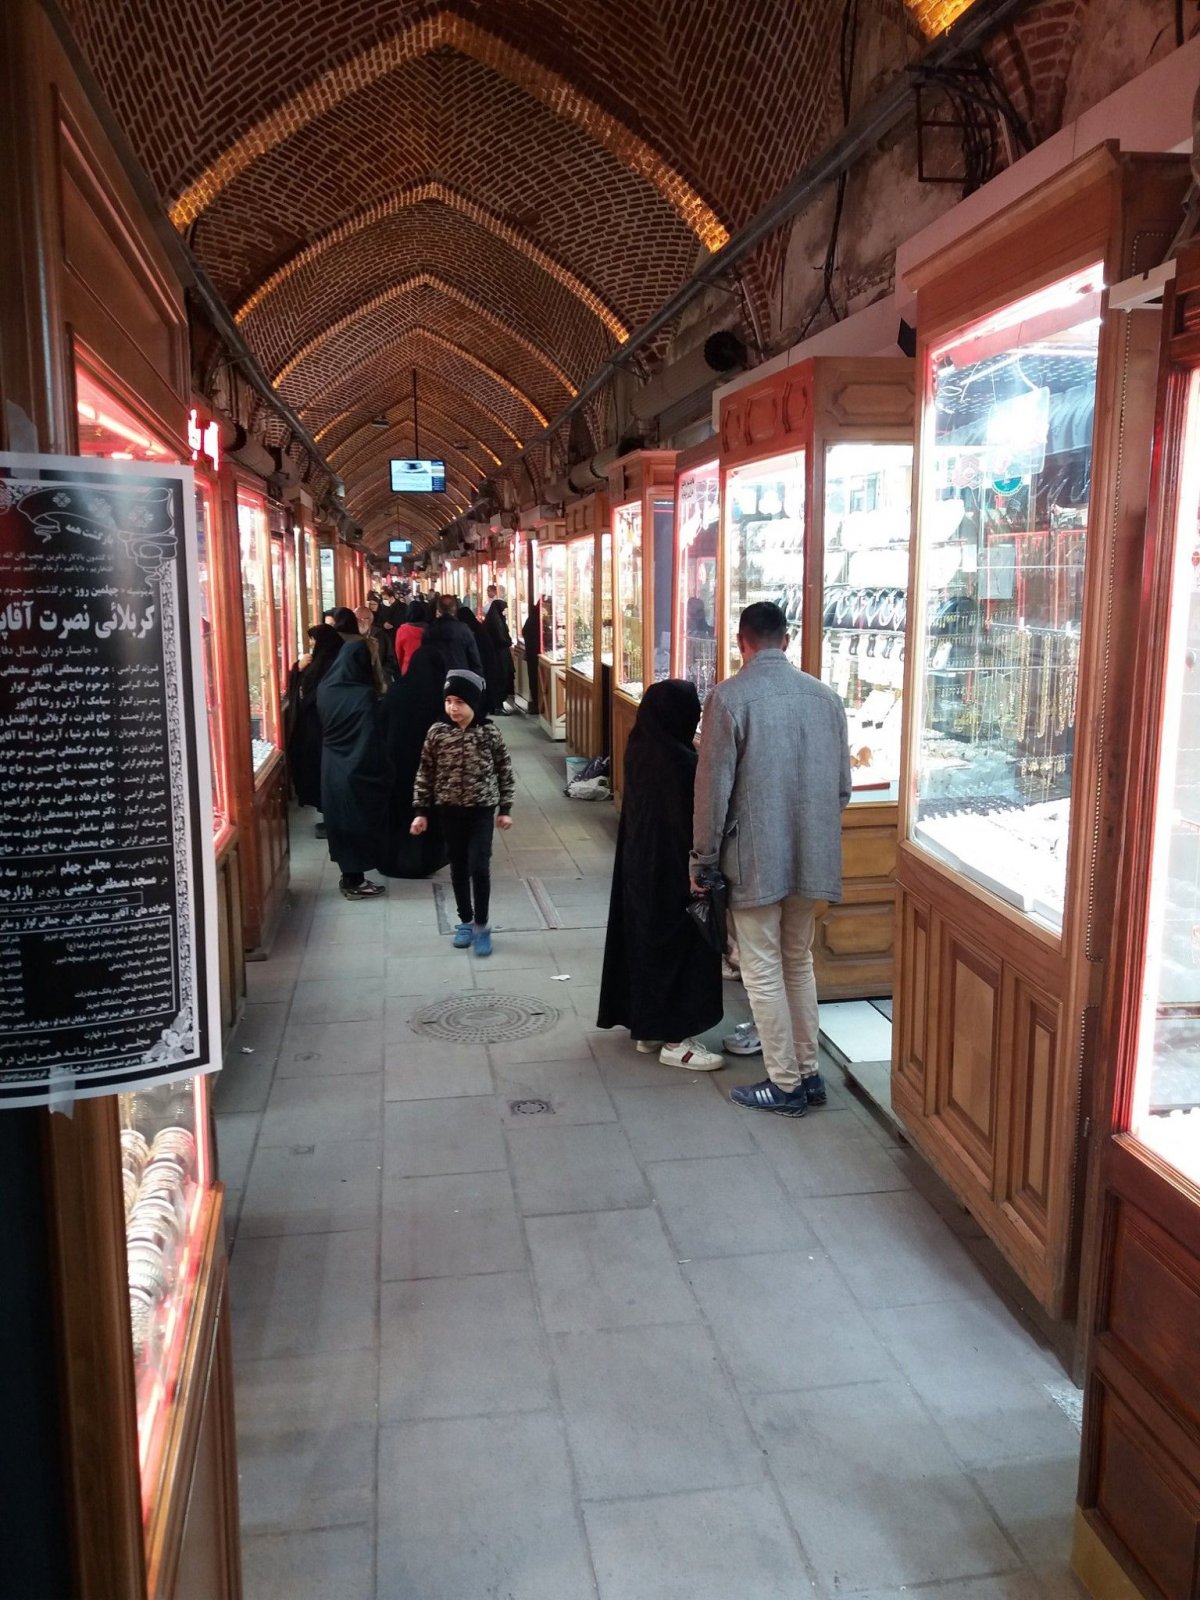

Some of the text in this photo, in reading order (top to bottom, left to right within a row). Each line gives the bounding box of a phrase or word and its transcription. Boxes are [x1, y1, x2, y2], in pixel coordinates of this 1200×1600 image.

[4, 587, 34, 597] مرحوم
[36, 584, 66, 597] درگذشت
[74, 586, 89, 598] روز
[91, 584, 119, 598] چهلمین
[40, 604, 90, 639] نصرت
[95, 602, 155, 639] کربلائی
[41, 645, 92, 658] جانباز دوران
[0, 665, 29, 677] مصطفی
[55, 664, 84, 677] مصطفی
[85, 666, 109, 677] مرحوم
[118, 664, 140, 676] گرامی
[142, 664, 159, 675] فرزند
[27, 680, 51, 693] جمالی
[69, 680, 85, 692] حاج
[86, 680, 110, 692] مرحوم
[118, 680, 141, 692] گرامی
[144, 680, 160, 688] داماد
[40, 698, 54, 709] رضا
[56, 700, 60, 708] و
[62, 696, 80, 708] آرش
[86, 696, 111, 707] سیامک
[5, 714, 38, 726] ابوالفضل
[74, 712, 95, 724] قدرت
[96, 711, 111, 723] حاج
[120, 711, 145, 721] ارجمند
[146, 711, 162, 721] برادر
[36, 733, 40, 742] و
[118, 728, 138, 738] مهربان
[0, 750, 25, 759] مرحوم
[89, 746, 114, 756] مرحوم
[122, 744, 139, 754] عزیز
[9, 759, 115, 775] حاج محمد حاج حسین و حاج
[54, 778, 77, 789] جمالی
[79, 778, 99, 787] حبیب
[100, 775, 115, 787] حاج
[124, 775, 145, 784] ارجمند
[1, 780, 17, 792] حاج
[19, 781, 44, 791] مرحوم
[58, 793, 73, 805] علی
[79, 791, 100, 803] فرهاد
[101, 790, 116, 802] حاج
[124, 789, 144, 801] گرامی
[4, 796, 30, 808] ابراهیم
[20, 810, 42, 823] زارعی
[74, 812, 79, 820] و
[80, 809, 100, 819] محمود
[102, 806, 116, 818] دکتر
[22, 826, 41, 839] نوری
[43, 827, 64, 835] محمد
[73, 822, 99, 835] ساسانی
[42, 840, 57, 853] حاج
[100, 837, 115, 849] حاج
[122, 835, 138, 847] گرامی
[22, 842, 40, 854] حیدر
[84, 858, 111, 875] مجلس
[141, 856, 156, 868] اطلاع
[5, 867, 17, 877] سه
[60, 860, 82, 877] چهلم
[64, 879, 94, 897] خمینی
[96, 877, 130, 894] مصطفی
[132, 876, 157, 889] مسجد
[149, 903, 171, 915] خانواده
[38, 916, 60, 928] جمالی
[85, 910, 109, 923] مصطفی
[94, 1042, 119, 1056] ختم
[120, 1038, 151, 1052] مجلس
[64, 1046, 92, 1058] زنانه
[17, 1052, 62, 1065] همزمان
